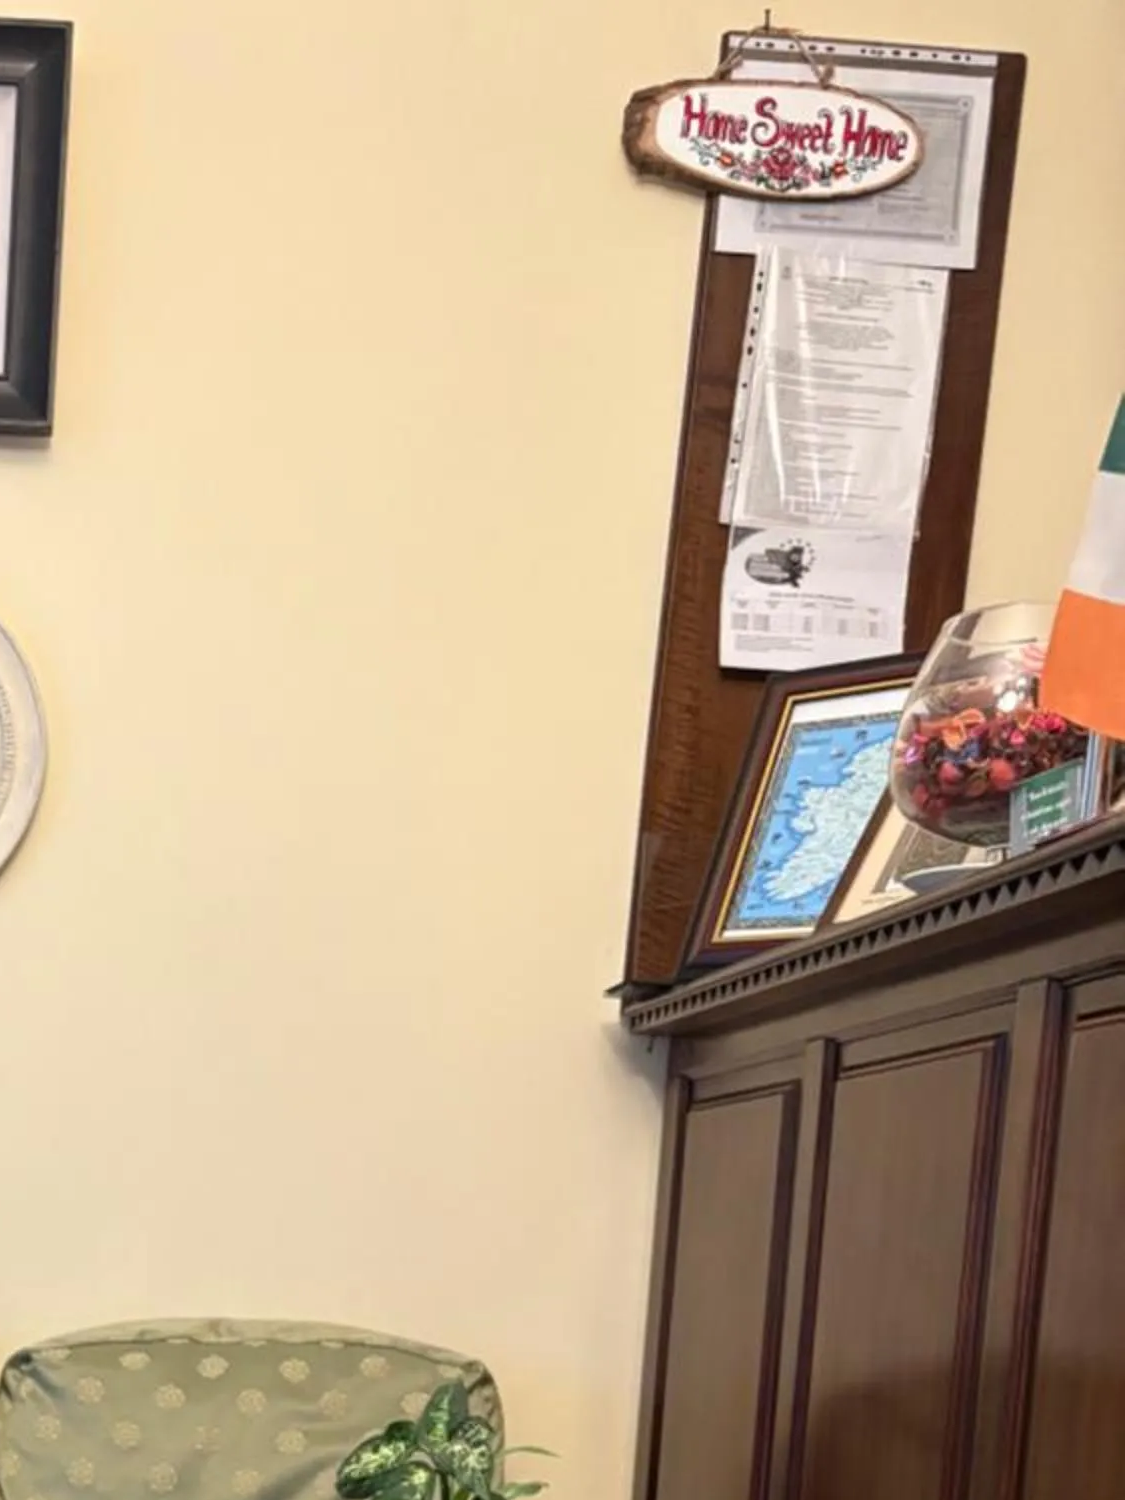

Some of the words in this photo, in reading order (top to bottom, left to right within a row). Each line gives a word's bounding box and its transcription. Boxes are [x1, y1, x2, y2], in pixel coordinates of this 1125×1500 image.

[681, 95, 748, 144] Home
[751, 97, 835, 155] Sweet
[839, 104, 909, 161] Home
